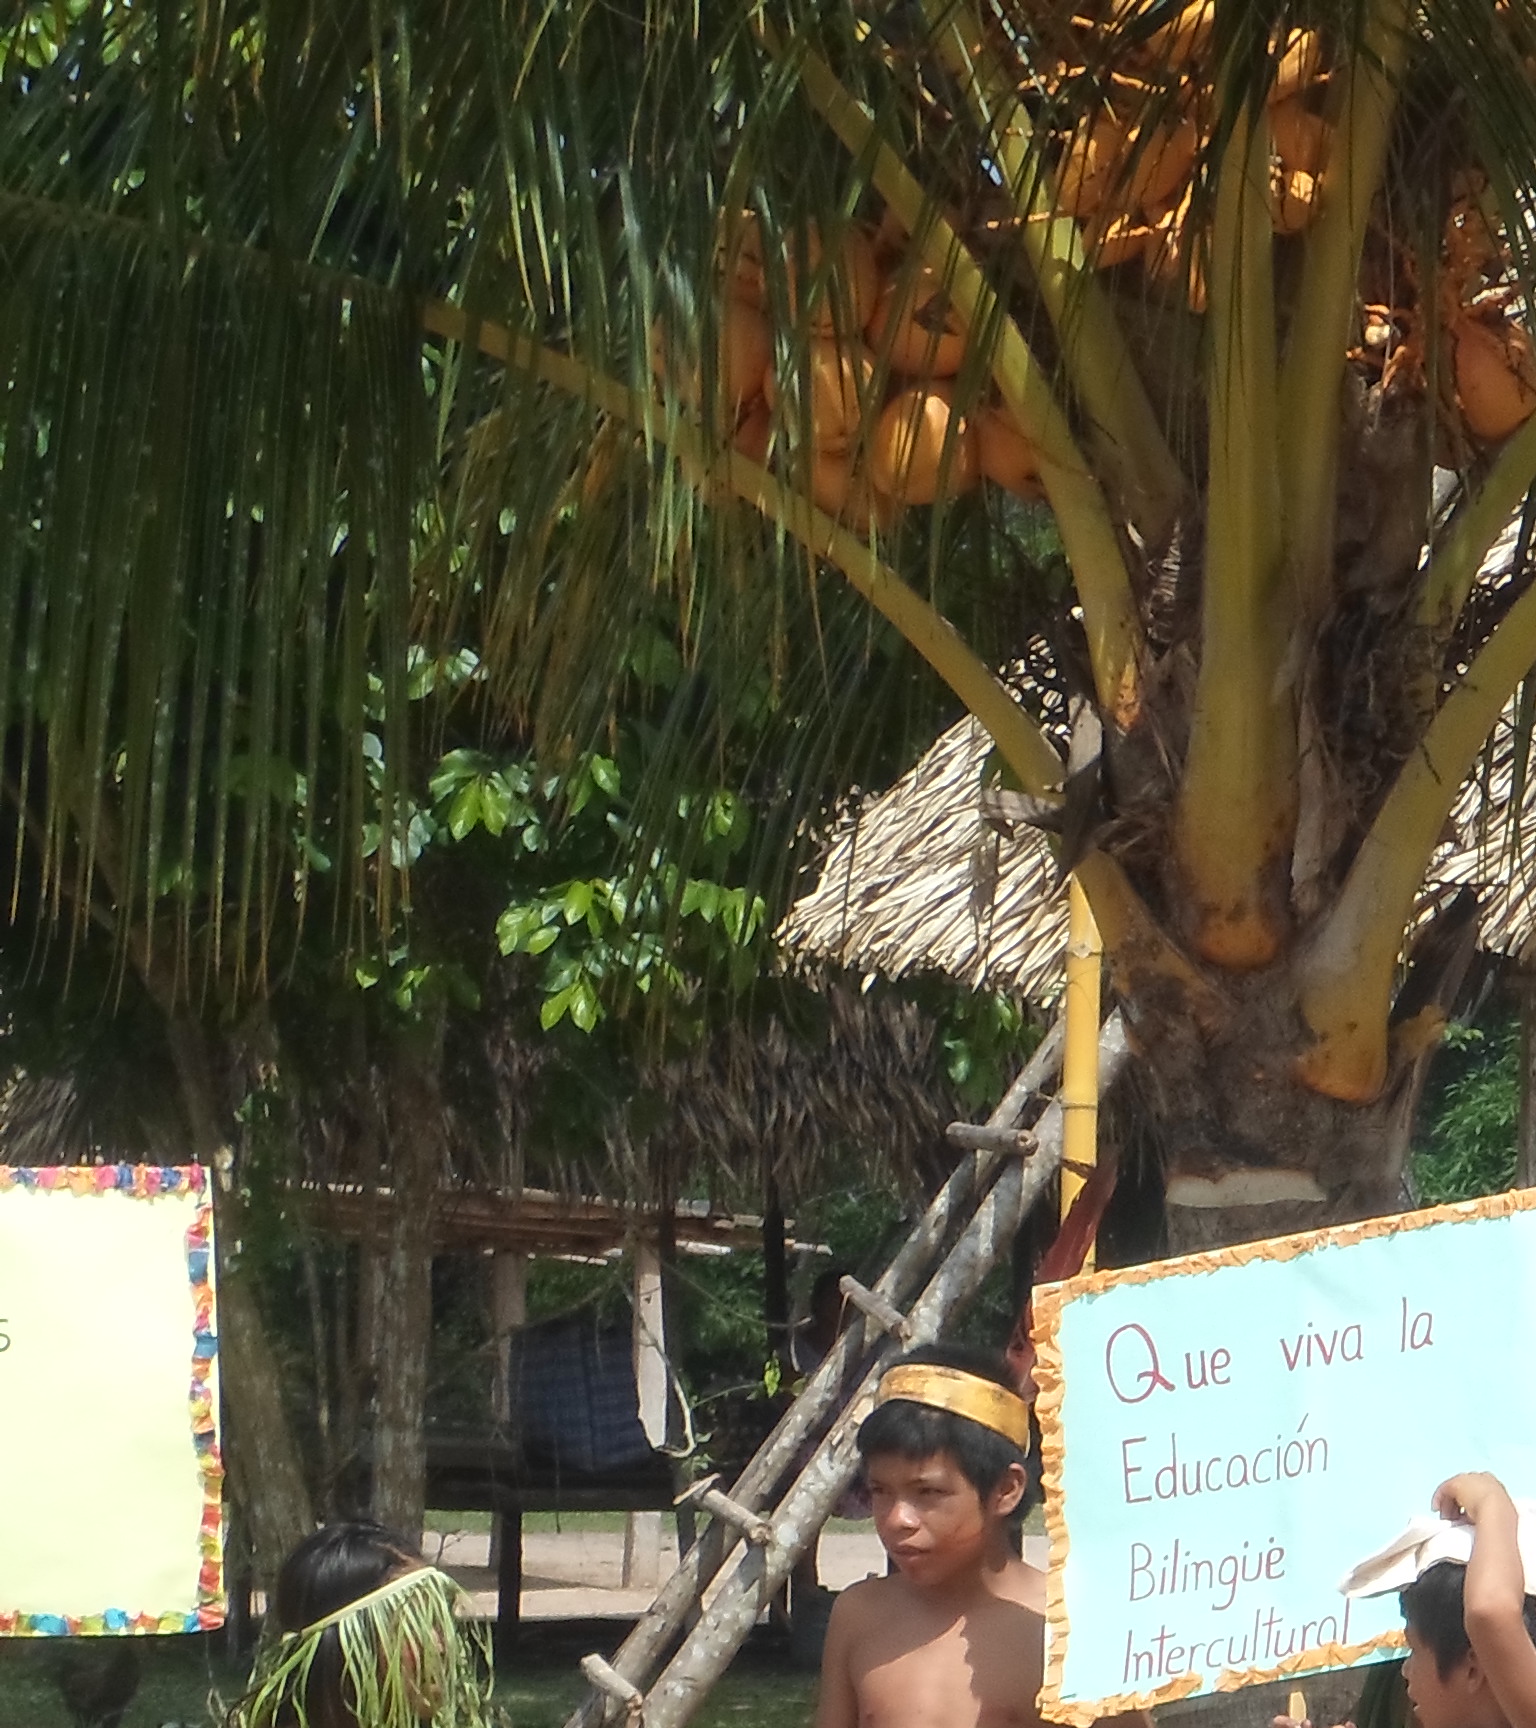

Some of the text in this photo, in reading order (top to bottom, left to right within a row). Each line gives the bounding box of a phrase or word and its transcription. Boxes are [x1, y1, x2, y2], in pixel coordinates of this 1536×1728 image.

[1105, 1296, 1434, 1403] Que viva la
[1122, 1412, 1329, 1504] Educación
[1129, 1536, 1286, 1611] Bilingüe
[1122, 1597, 1350, 1683] Intercultural
